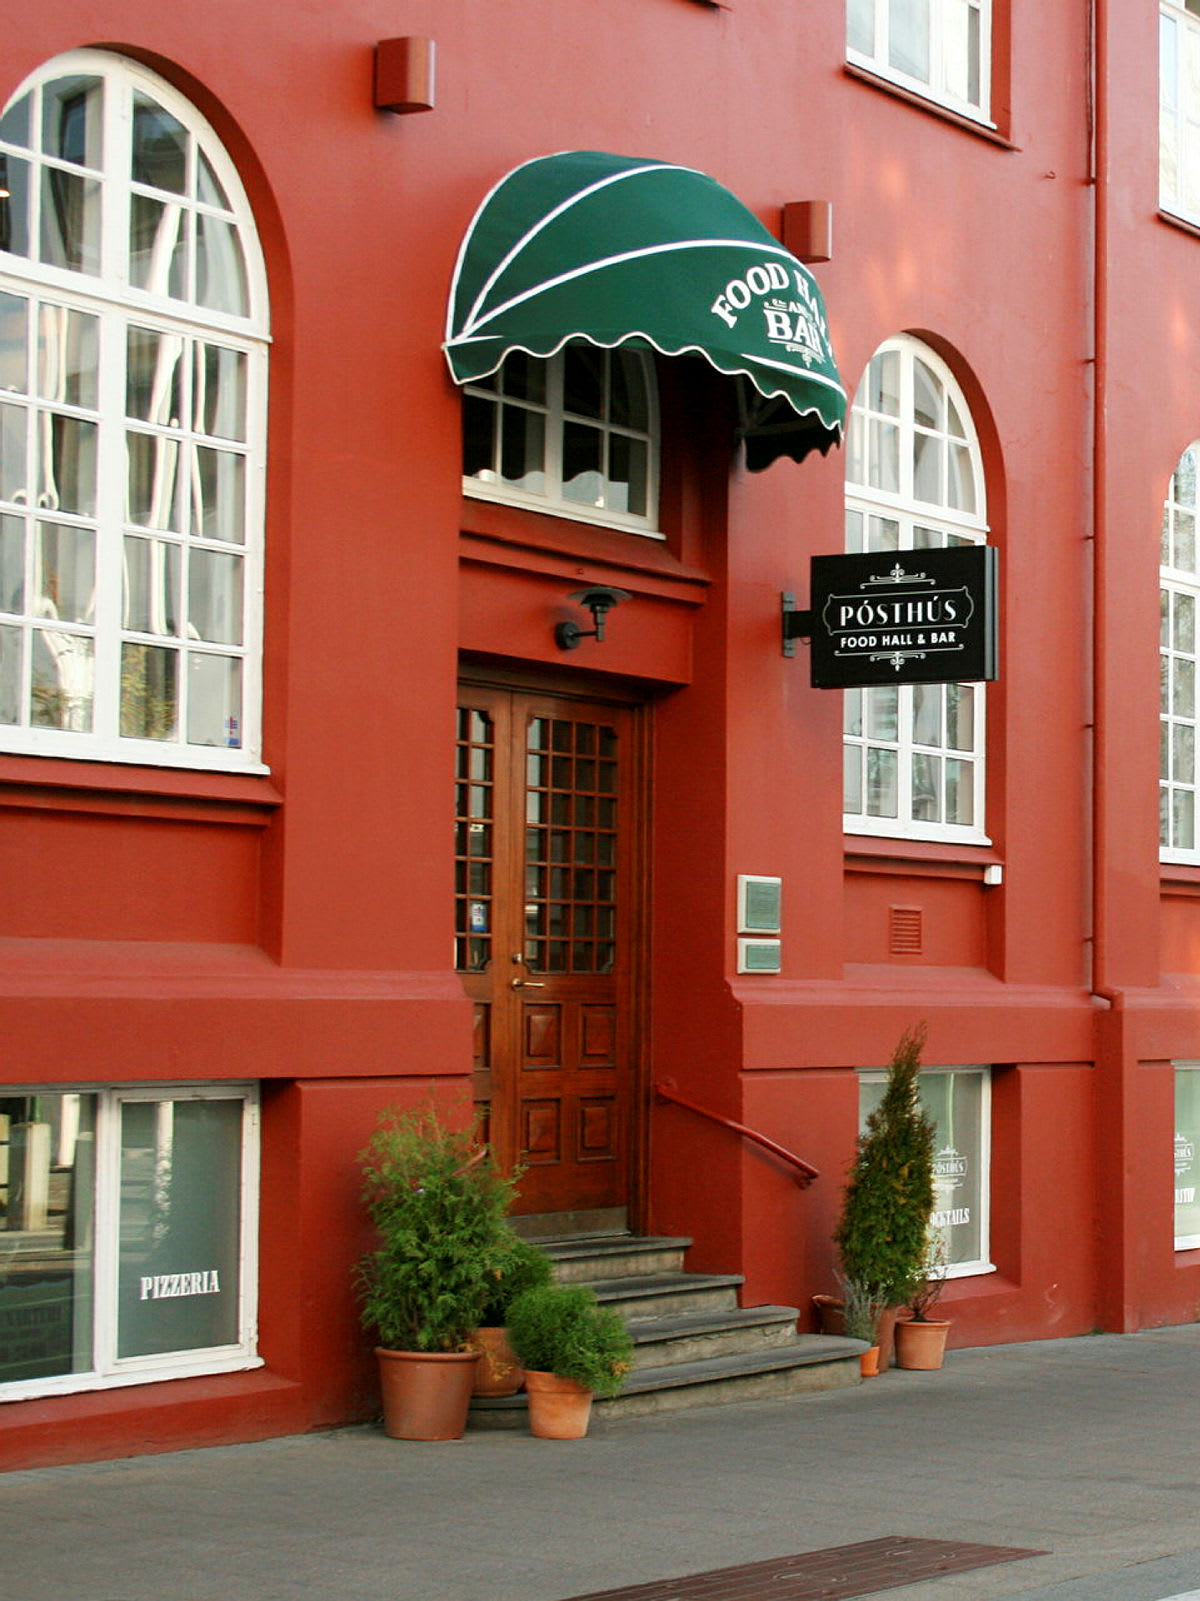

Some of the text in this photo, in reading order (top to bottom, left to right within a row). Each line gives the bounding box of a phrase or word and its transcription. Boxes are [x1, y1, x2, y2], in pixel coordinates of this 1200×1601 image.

[711, 263, 789, 329] FOOD
[763, 309, 824, 358] BAR
[840, 596, 957, 627] PÓSTHÚS
[840, 631, 956, 648] FOOD HALL & BAR
[140, 1270, 220, 1300] PIZZERIA
